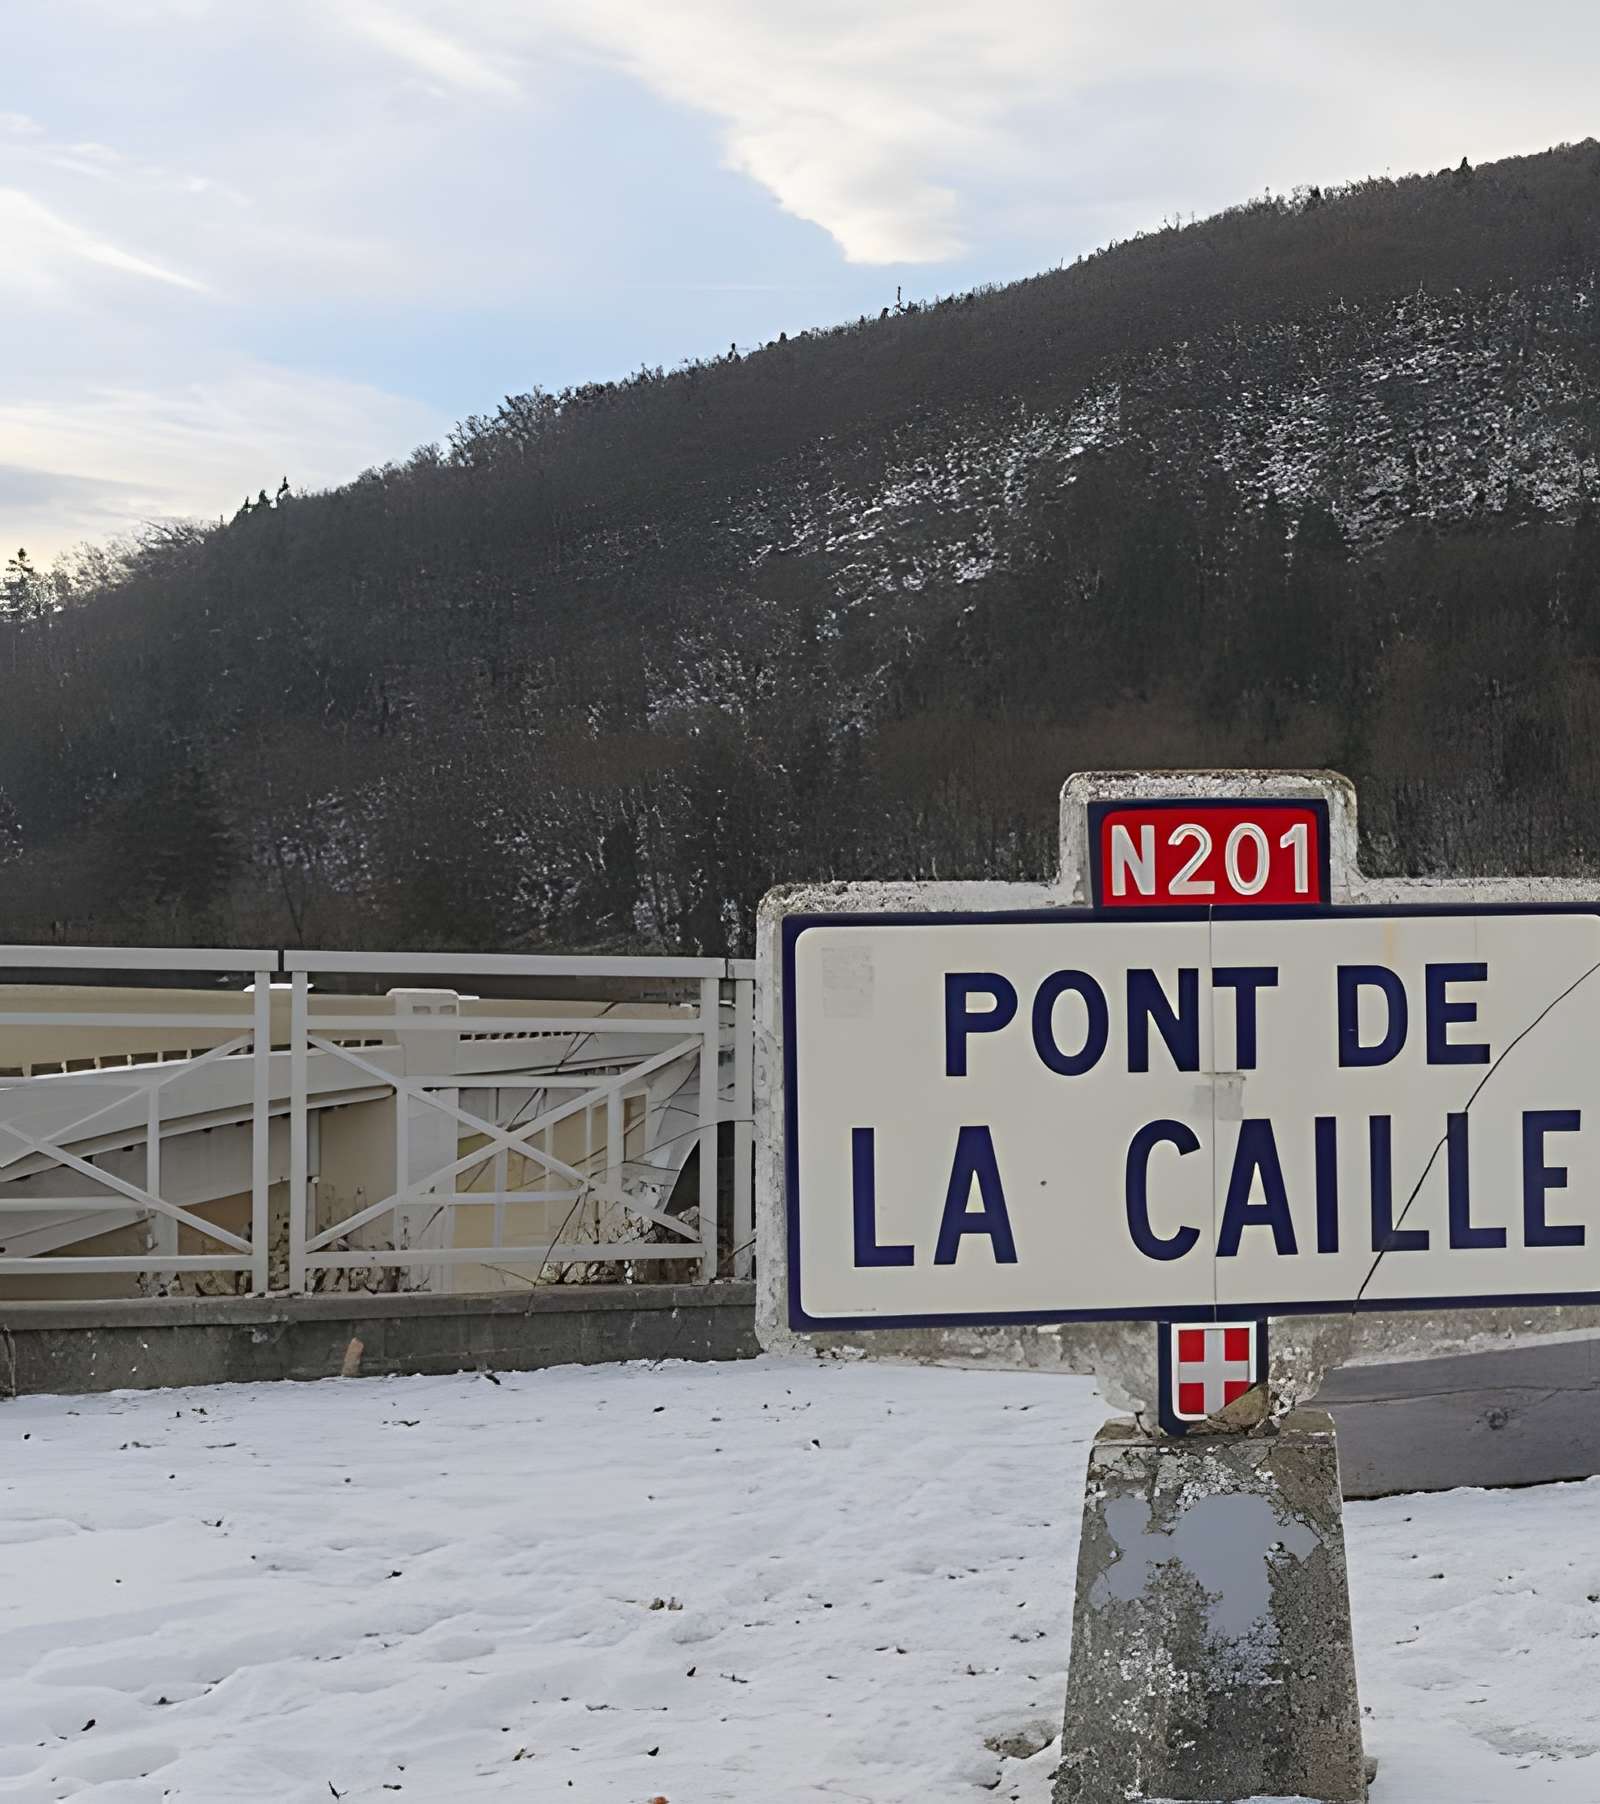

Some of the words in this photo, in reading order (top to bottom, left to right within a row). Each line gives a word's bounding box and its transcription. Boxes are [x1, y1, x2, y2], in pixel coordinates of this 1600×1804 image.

[1109, 822, 1312, 897] N201
[944, 966, 1279, 1077] PONT
[1337, 962, 1491, 1068] DE
[851, 1125, 1018, 1268] LA
[1125, 1109, 1586, 1261] CAILLE
